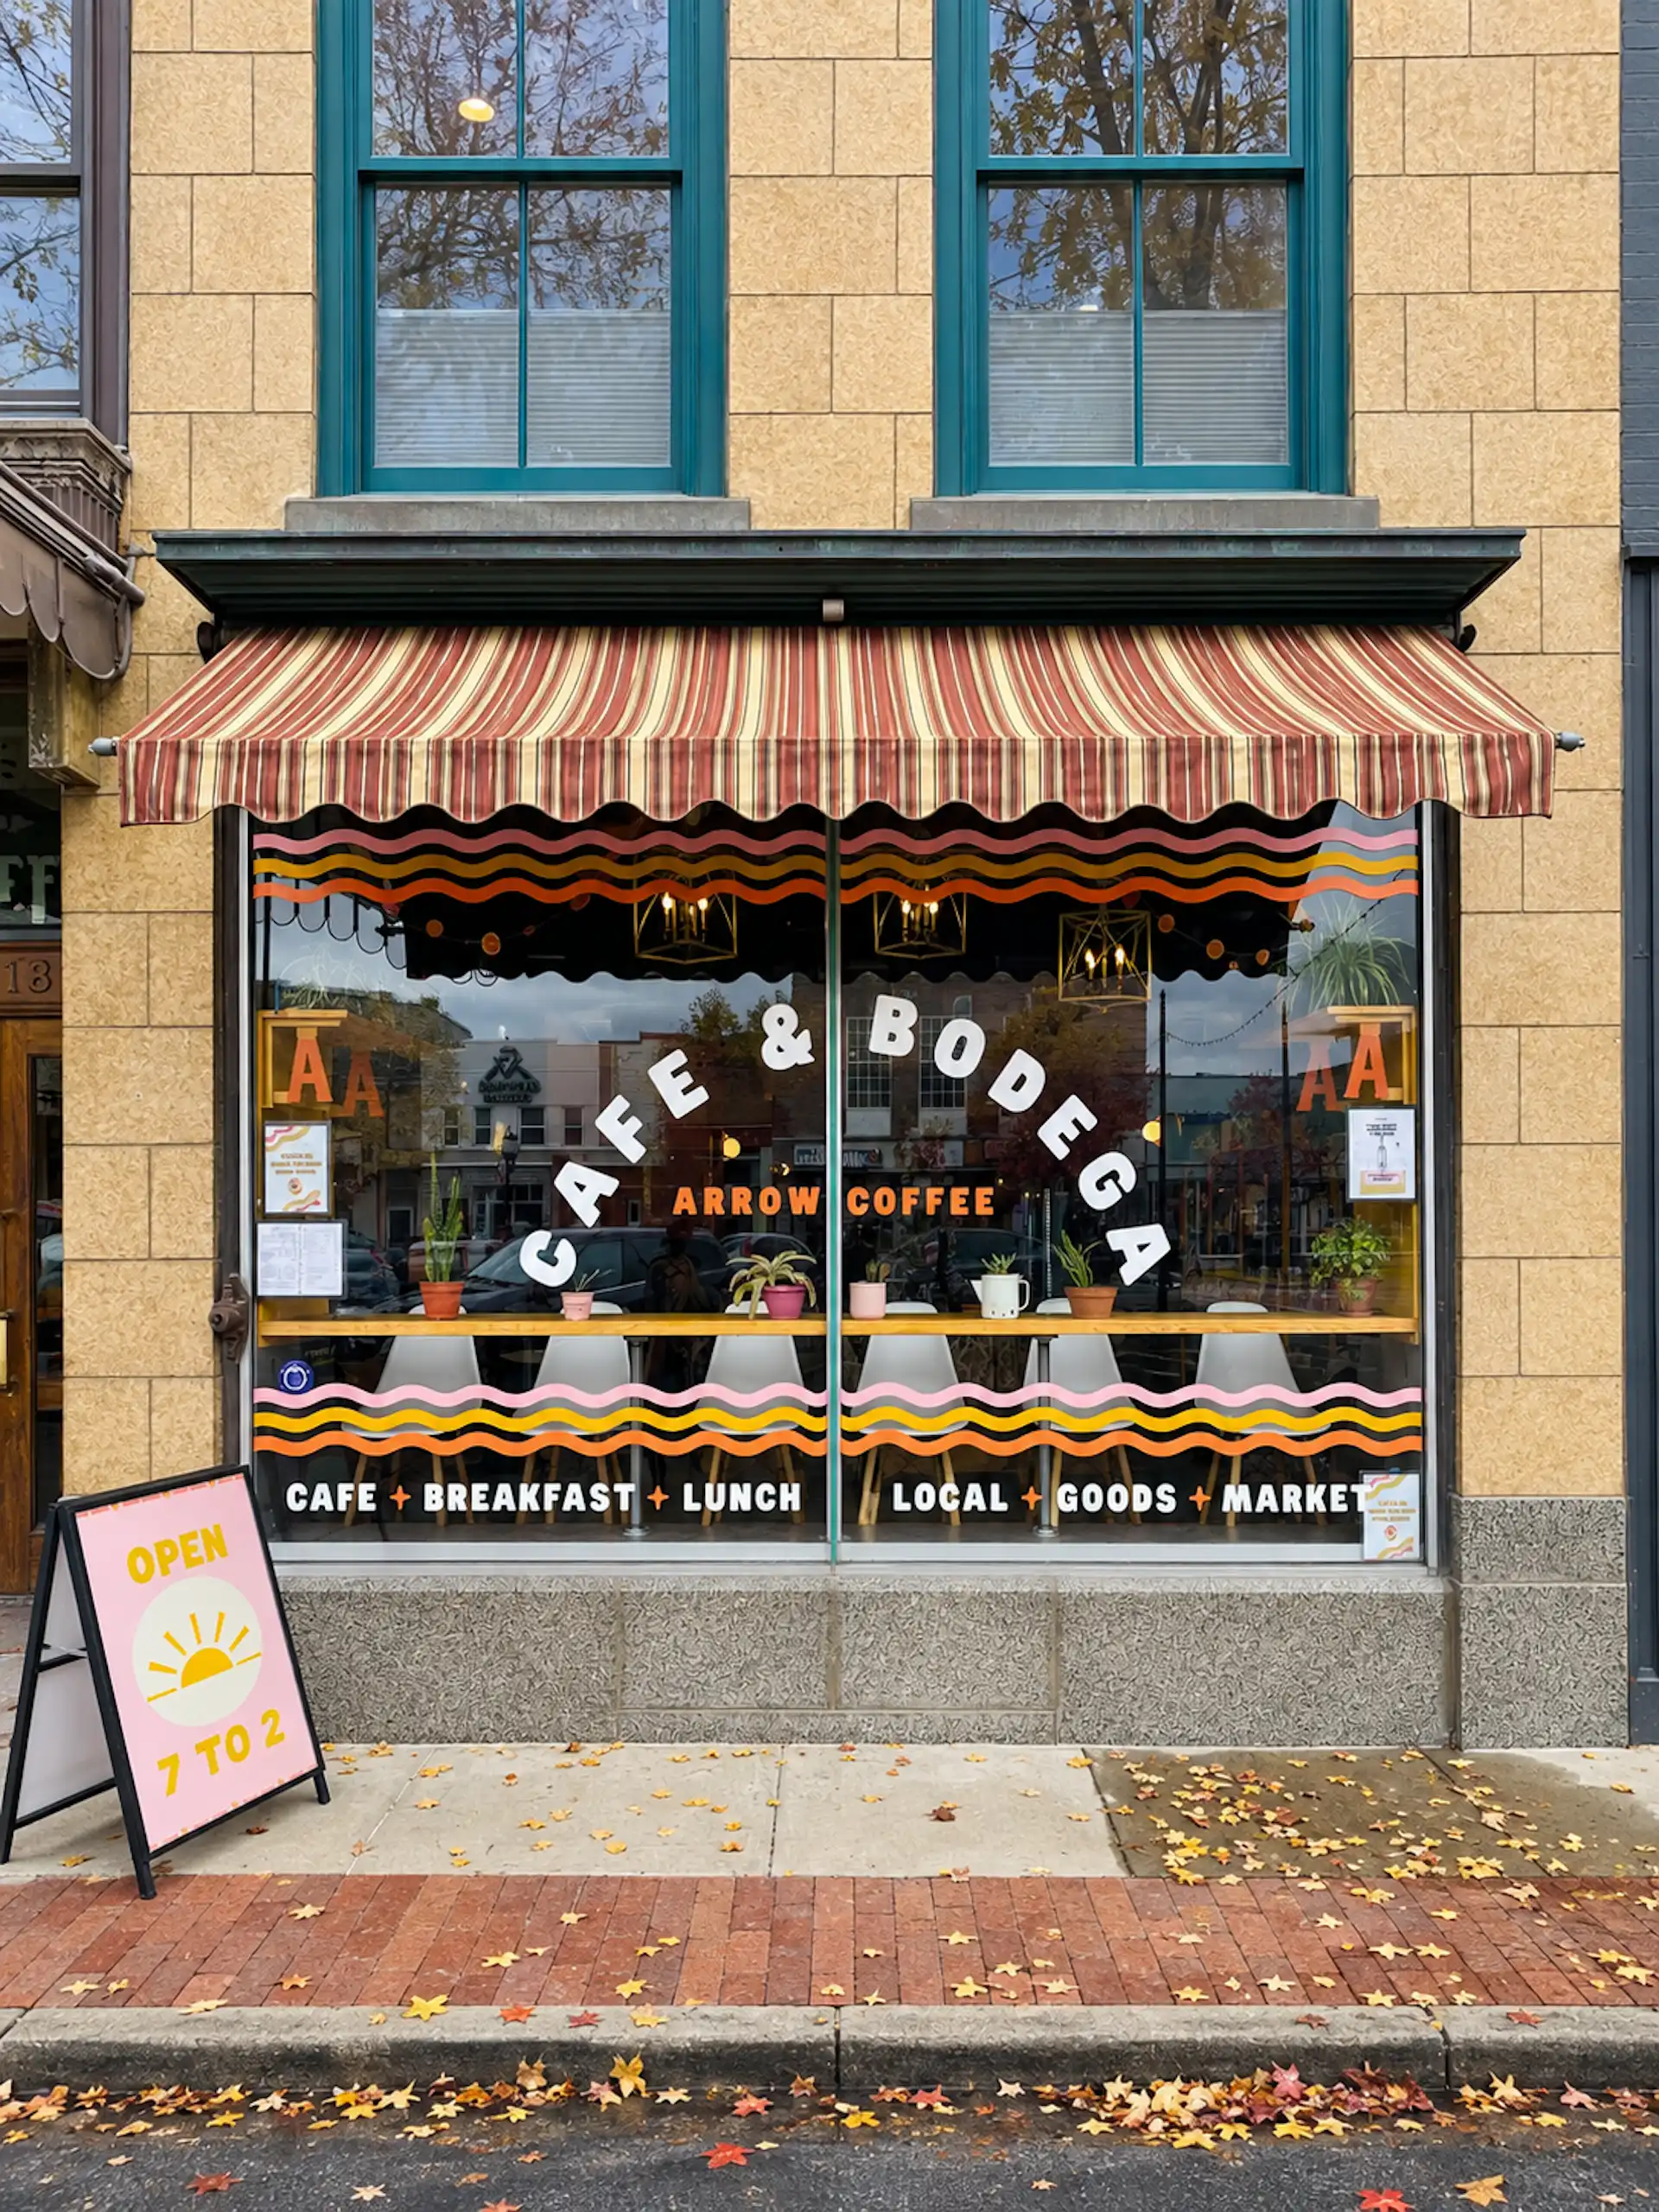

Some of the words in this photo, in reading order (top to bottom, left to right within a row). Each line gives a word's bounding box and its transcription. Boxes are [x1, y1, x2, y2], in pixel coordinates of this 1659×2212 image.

[518, 1048, 709, 1287] CAFE
[760, 1003, 816, 1071] &
[868, 995, 1172, 1287] BODEGA
[672, 1185, 820, 1216] ARROW
[847, 1186, 995, 1216] COFFEE
[286, 1482, 378, 1512] CAFE
[423, 1482, 637, 1512] BREAKFAST
[683, 1482, 802, 1512] LUNCH
[893, 1482, 1008, 1512] LOCAL
[1056, 1483, 1178, 1513] GOODS
[1221, 1483, 1372, 1514] MARKET
[126, 1522, 229, 1585] OPEN
[156, 1751, 181, 1797] 7
[194, 1723, 251, 1777] TO
[260, 1707, 286, 1748] 2
